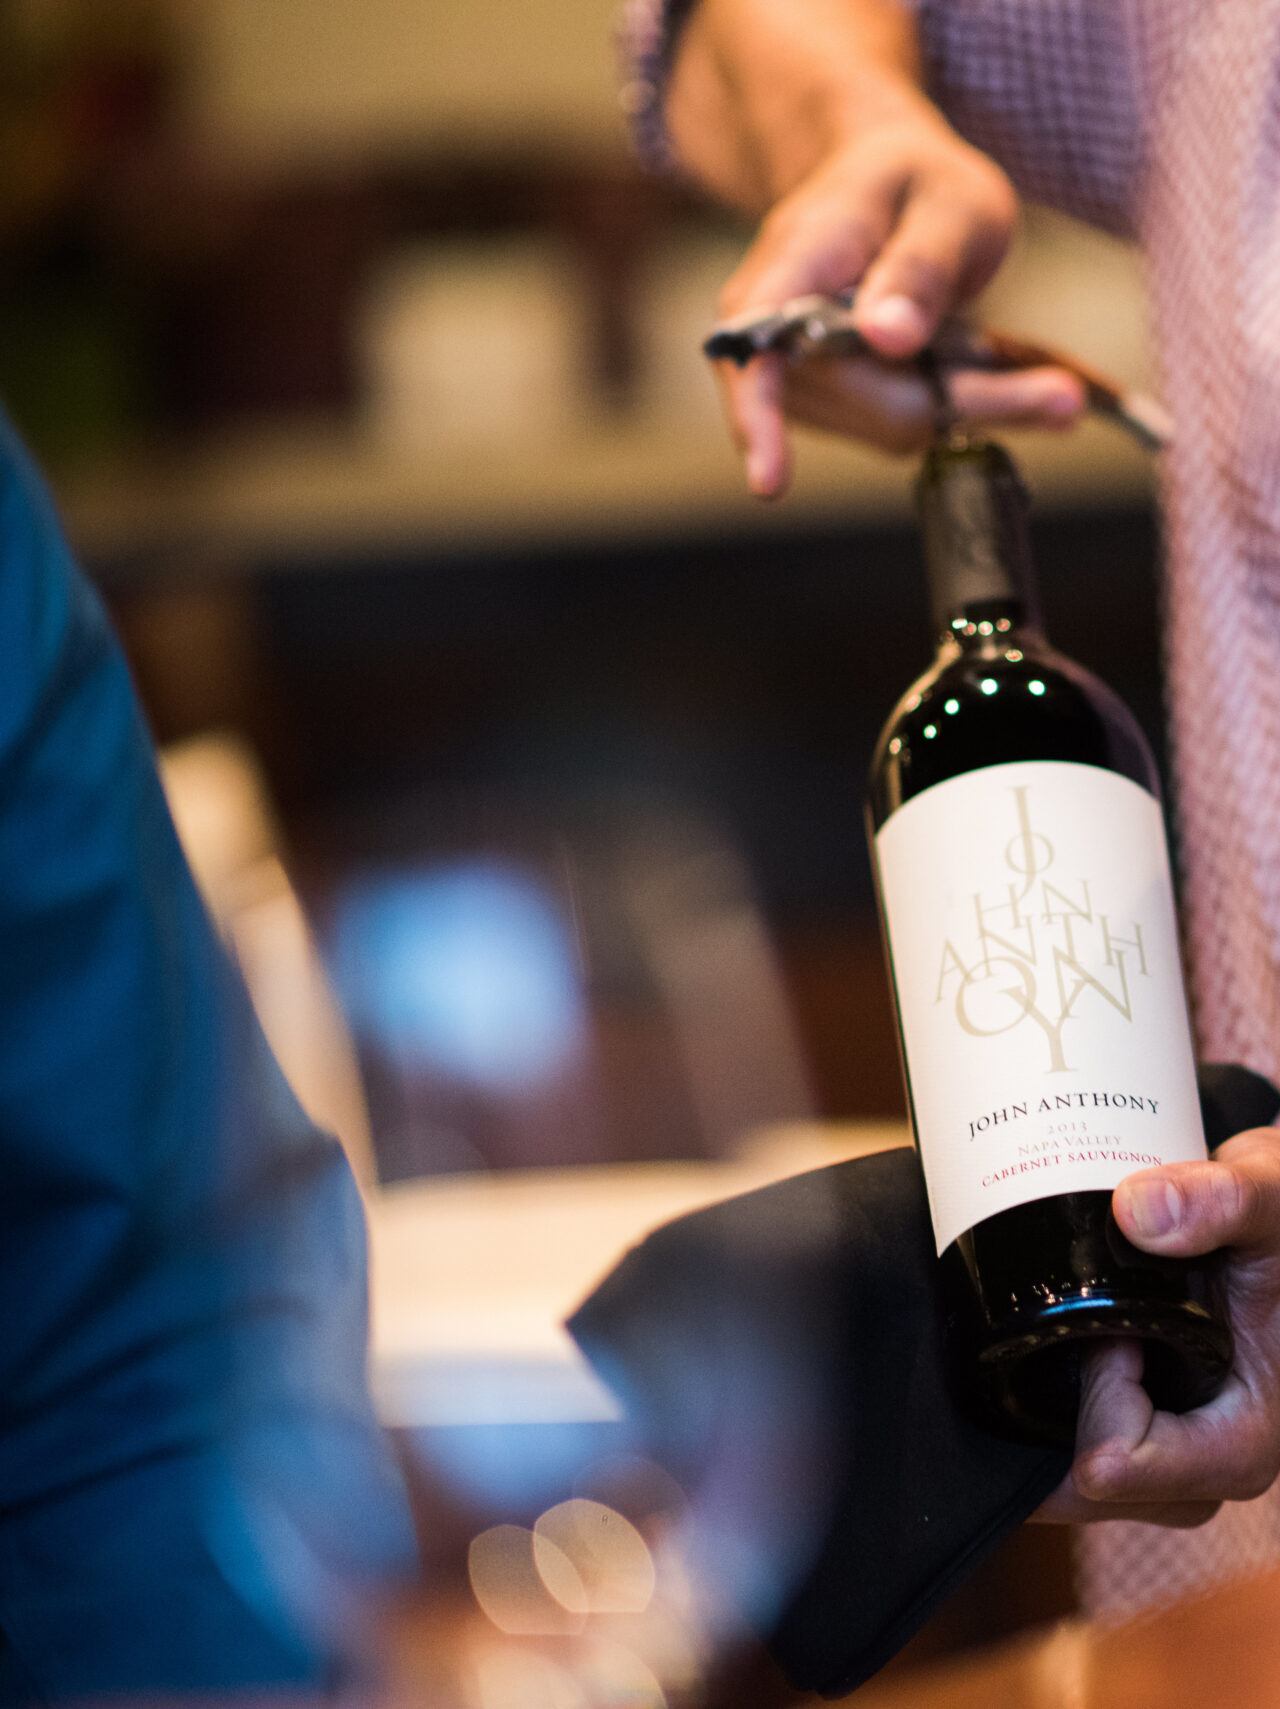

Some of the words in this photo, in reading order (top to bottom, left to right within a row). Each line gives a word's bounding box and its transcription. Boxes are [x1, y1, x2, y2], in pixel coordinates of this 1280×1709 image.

[968, 1101, 1028, 1141] JOHN
[1037, 1092, 1160, 1115] ANTHONY
[1048, 1121, 1088, 1135] 2013
[1018, 1139, 1060, 1157] NAPA
[1063, 1134, 1122, 1147] VALLEY
[981, 1154, 1062, 1188] CABERNET
[1068, 1150, 1163, 1167] SAUVIGNON
